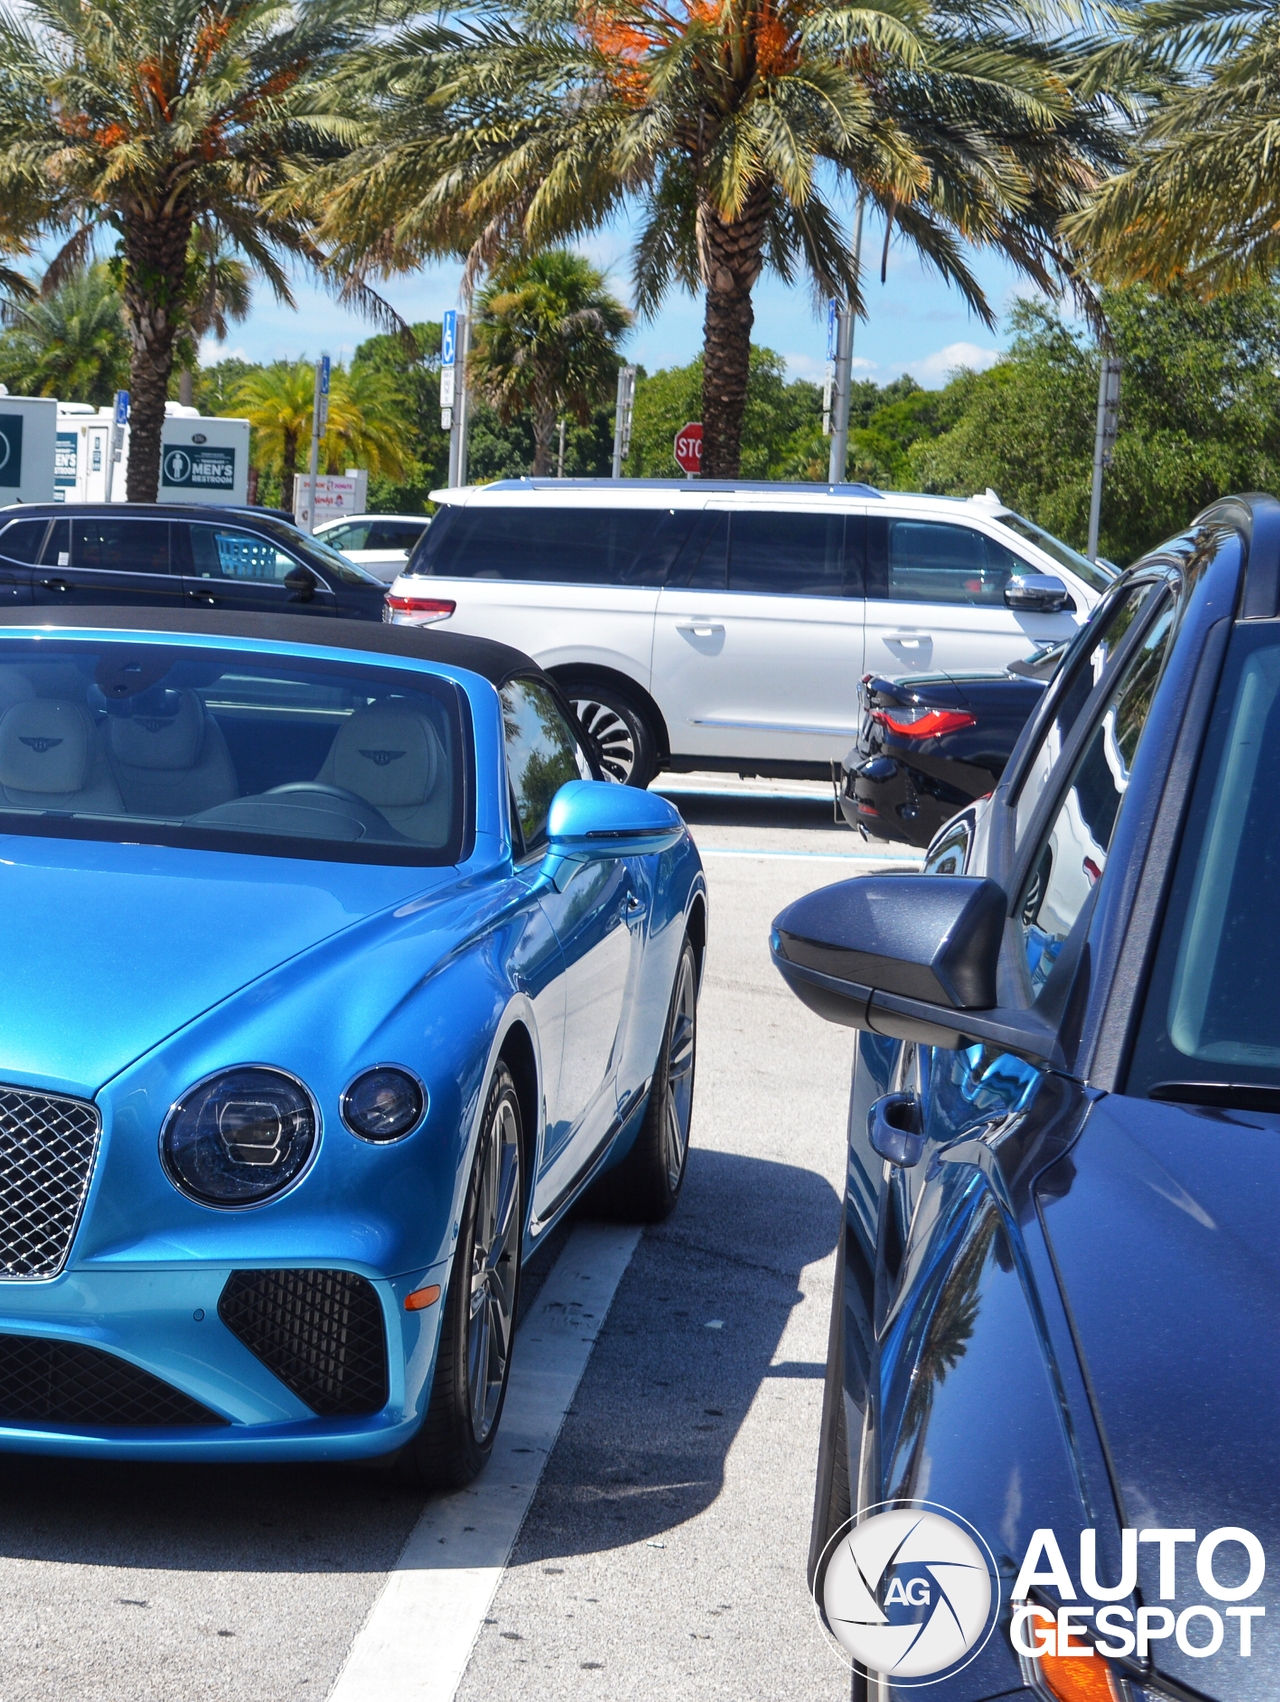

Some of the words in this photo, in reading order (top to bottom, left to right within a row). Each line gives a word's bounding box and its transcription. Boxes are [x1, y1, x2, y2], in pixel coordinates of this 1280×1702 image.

[677, 437, 702, 459] STO
[55, 453, 76, 467] EN'S
[192, 462, 233, 476] MEN'S
[191, 474, 233, 484] RESTROOM
